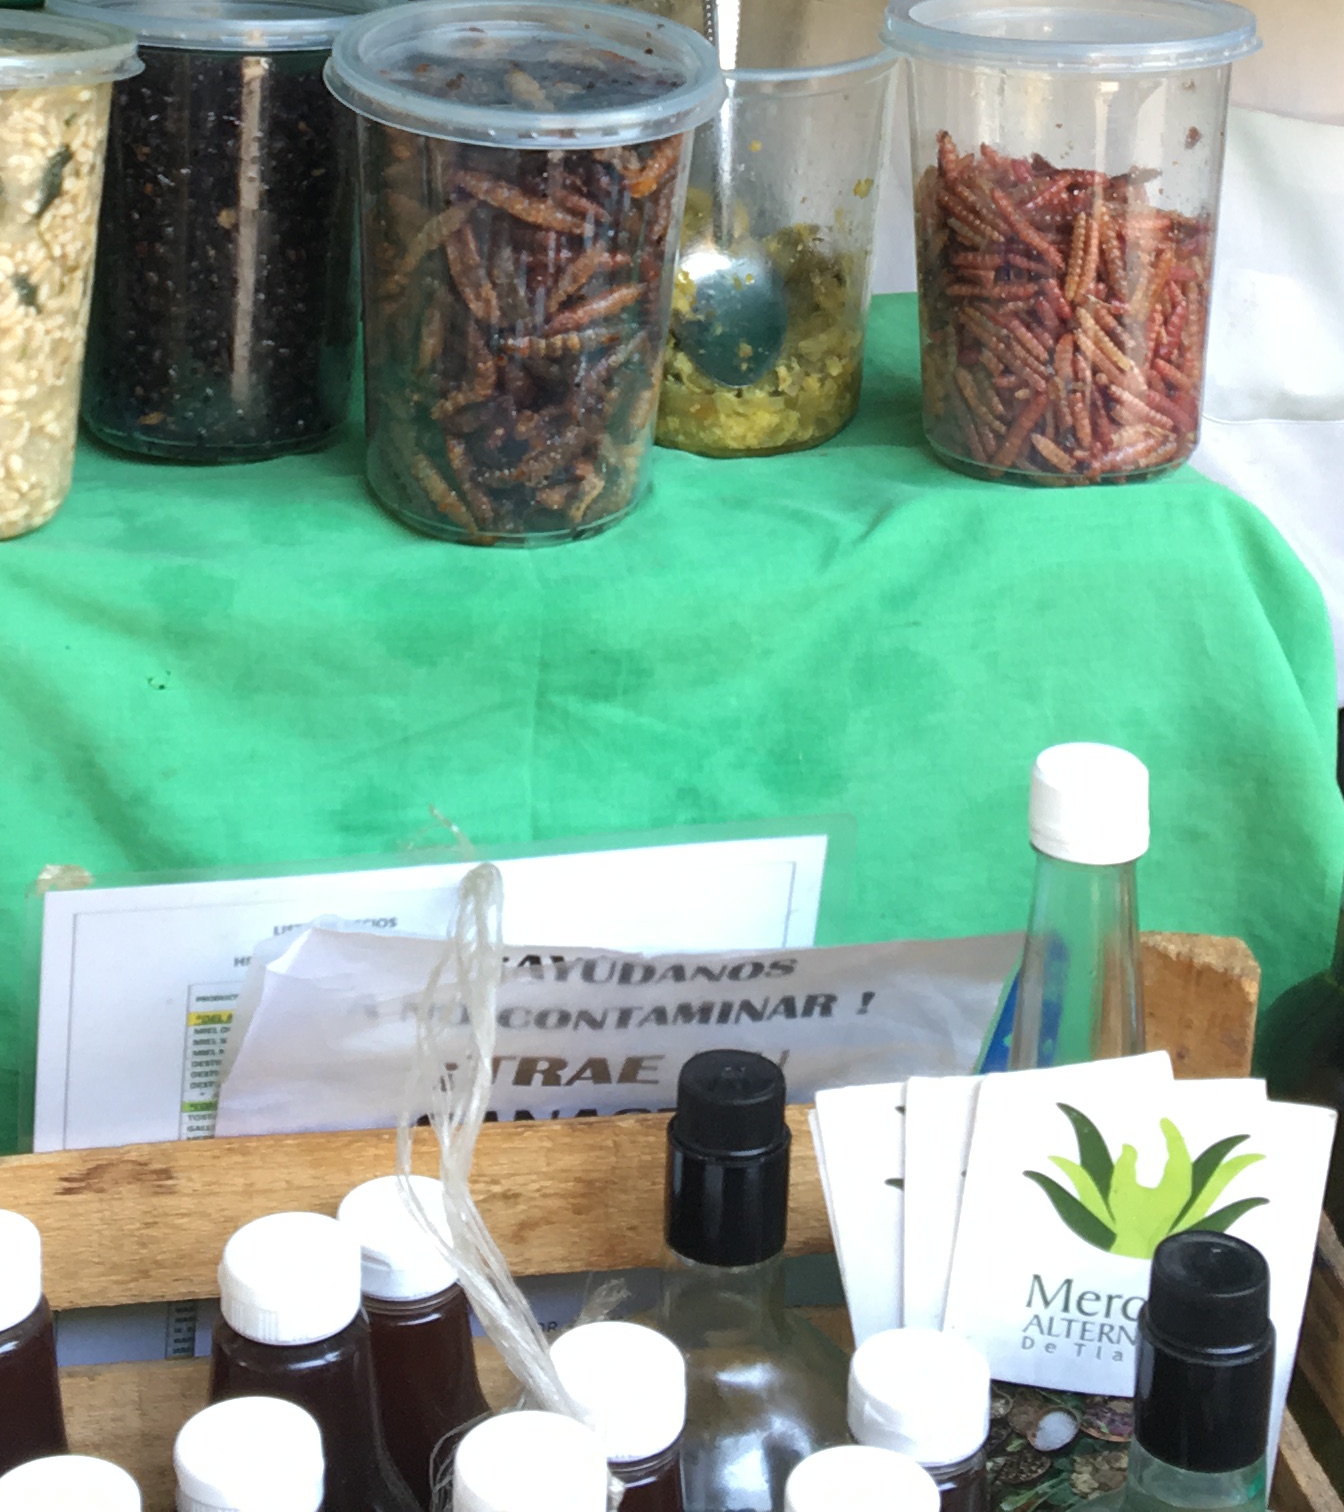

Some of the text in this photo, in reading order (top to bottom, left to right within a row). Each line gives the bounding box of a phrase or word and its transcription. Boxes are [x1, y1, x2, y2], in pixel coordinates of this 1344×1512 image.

[496, 992, 838, 1030] CONTAMINAR
[1021, 1313, 1137, 1347] ALTERN
[1020, 1335, 1124, 1363] De Tla
